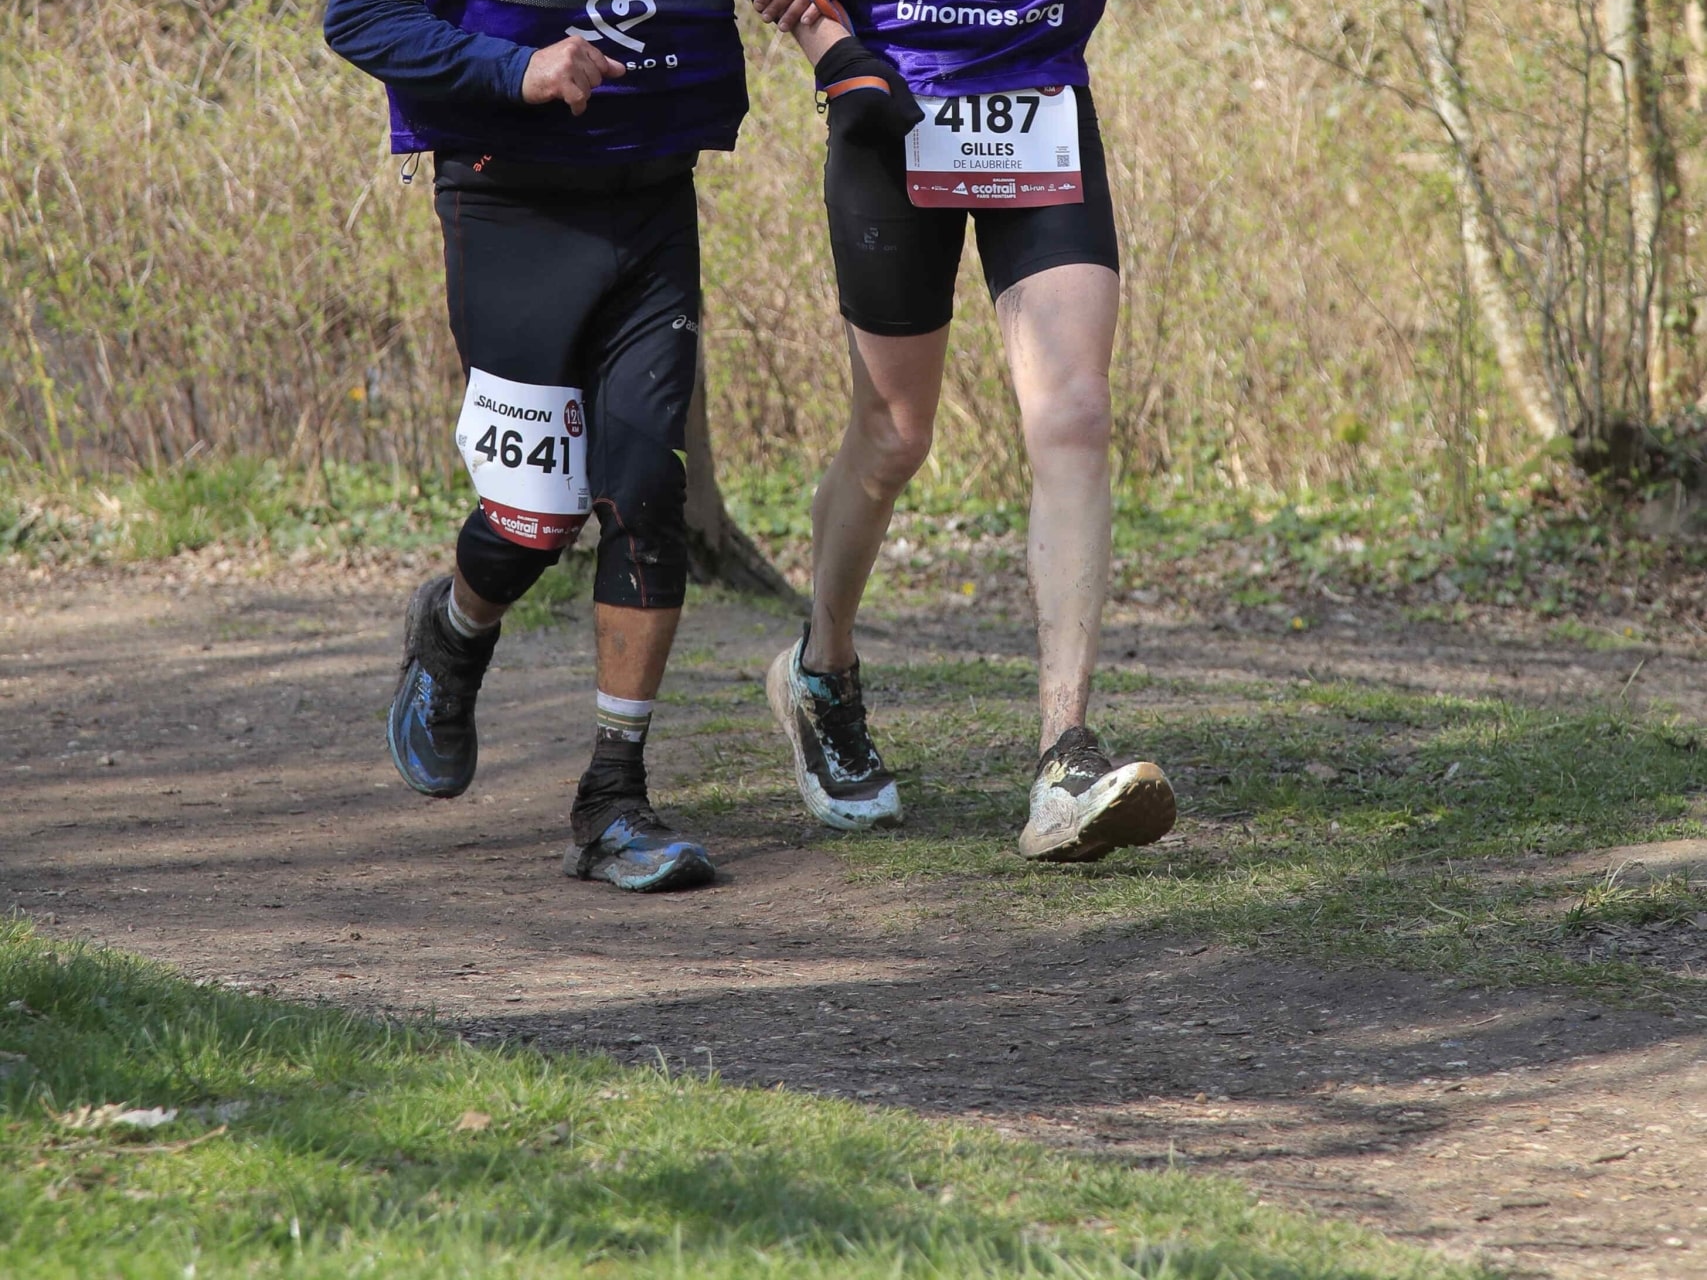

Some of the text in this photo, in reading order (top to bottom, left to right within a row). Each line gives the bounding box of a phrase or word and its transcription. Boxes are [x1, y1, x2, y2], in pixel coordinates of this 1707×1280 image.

[897, 0, 1065, 27] binomes.org
[934, 95, 1040, 133] 4187
[961, 142, 1014, 156] GILLES
[953, 158, 1023, 169] DE LAUBRIÈRE
[971, 183, 1016, 194] ecotrail
[477, 395, 552, 423] SALOMON
[475, 425, 570, 475] 4641
[501, 516, 538, 535] ecotrail
